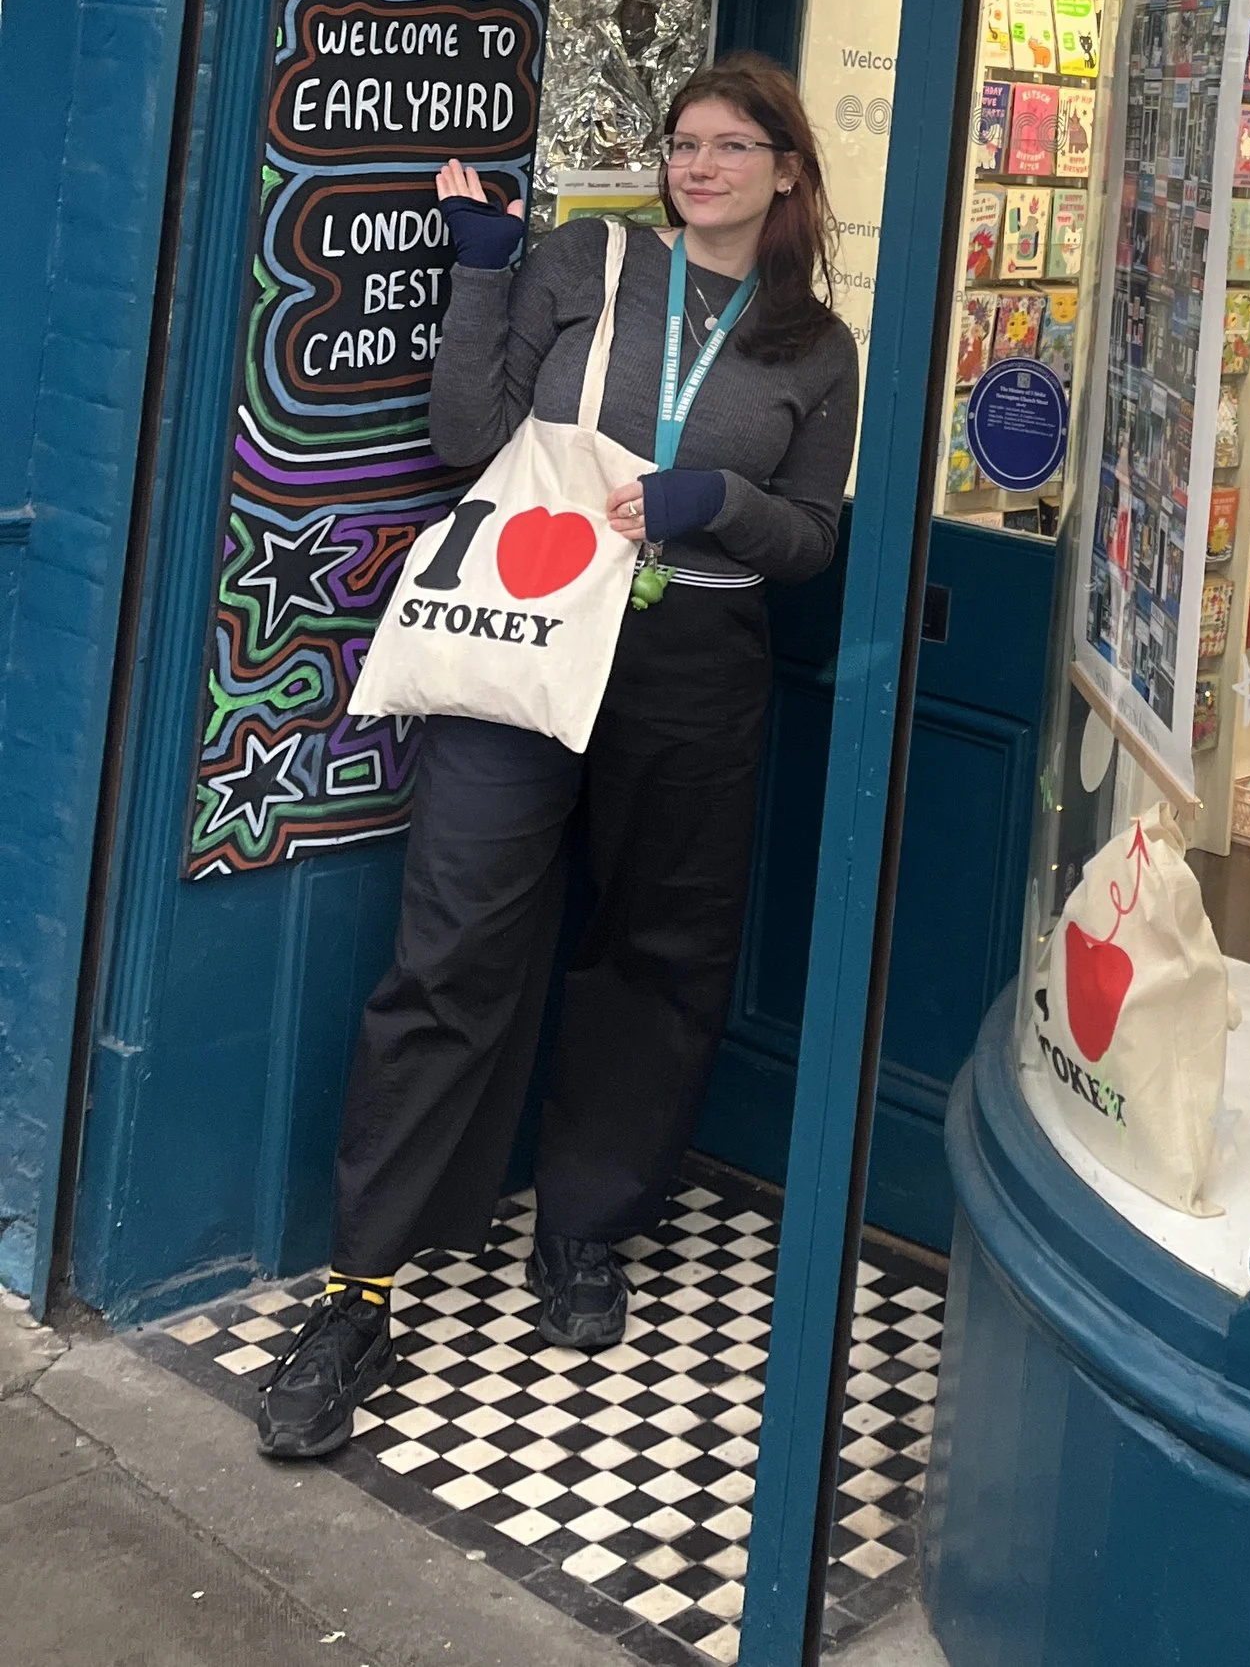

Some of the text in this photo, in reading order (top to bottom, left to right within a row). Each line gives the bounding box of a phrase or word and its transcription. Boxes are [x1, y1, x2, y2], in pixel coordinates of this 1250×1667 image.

[317, 18, 516, 59] WELCOME TO
[842, 48, 895, 71] Welco
[292, 78, 514, 132] EARLYBIRD
[364, 267, 443, 315] BEST
[302, 324, 396, 377] CARD
[665, 358, 677, 381] TEAM
[414, 499, 496, 591] I
[400, 598, 563, 648] STOKEY
